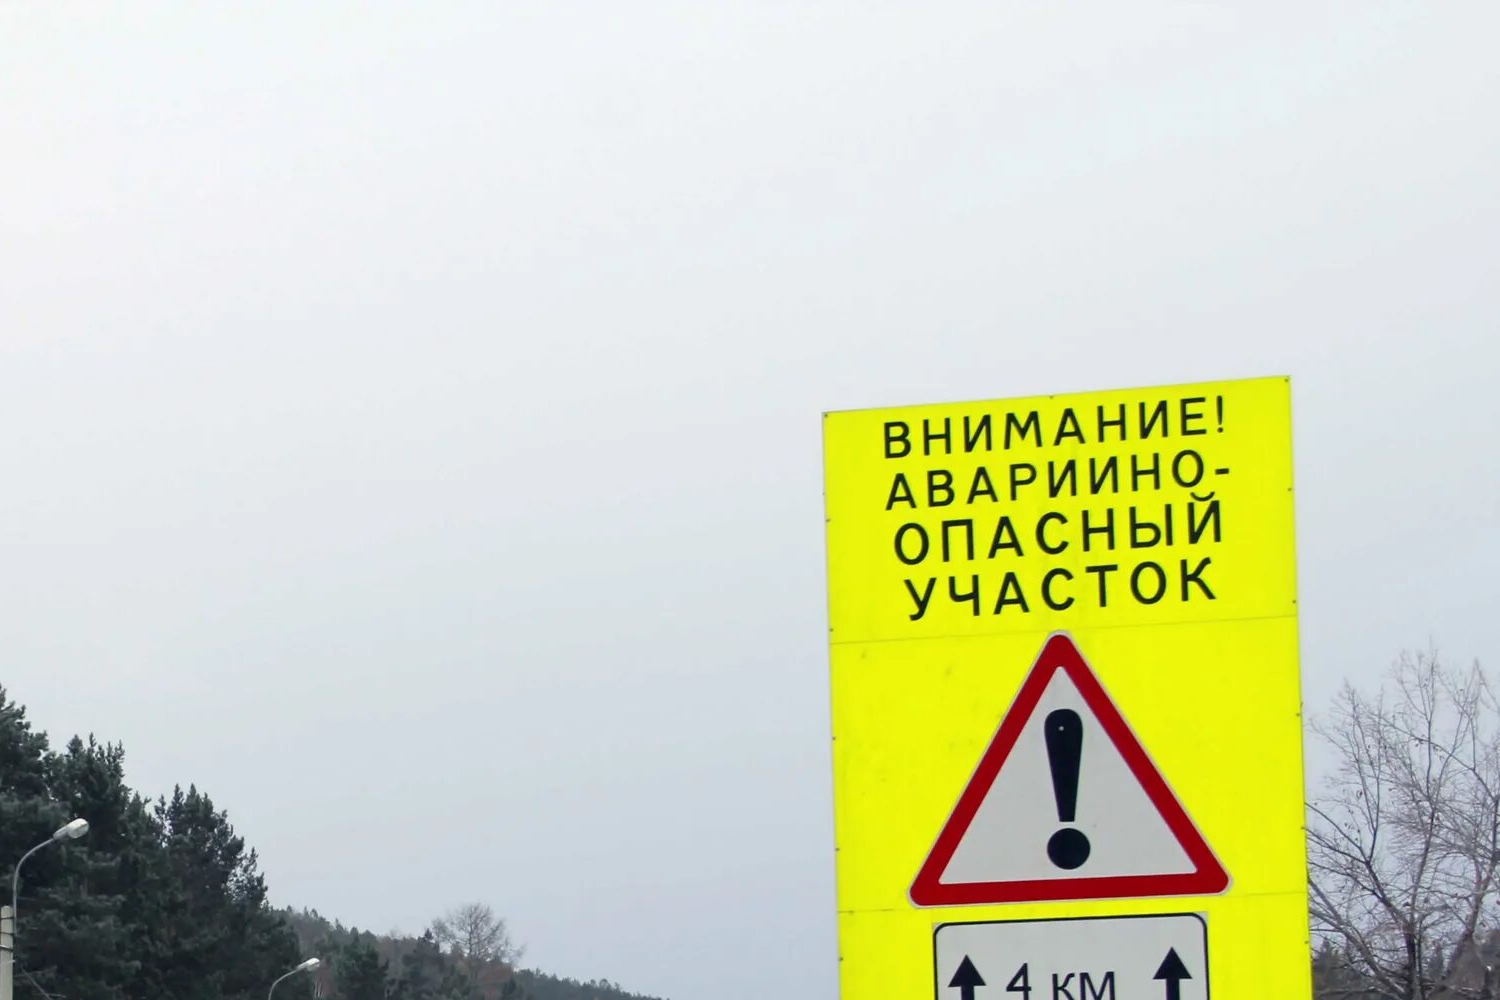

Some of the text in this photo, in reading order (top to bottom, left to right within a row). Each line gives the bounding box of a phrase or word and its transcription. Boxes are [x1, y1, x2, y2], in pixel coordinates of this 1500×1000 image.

[884, 395, 1224, 459] ВНИМАНИЕ!
[894, 491, 1222, 566] ОПАСНЫЙ
[904, 557, 1216, 621] УЧАСТОК
